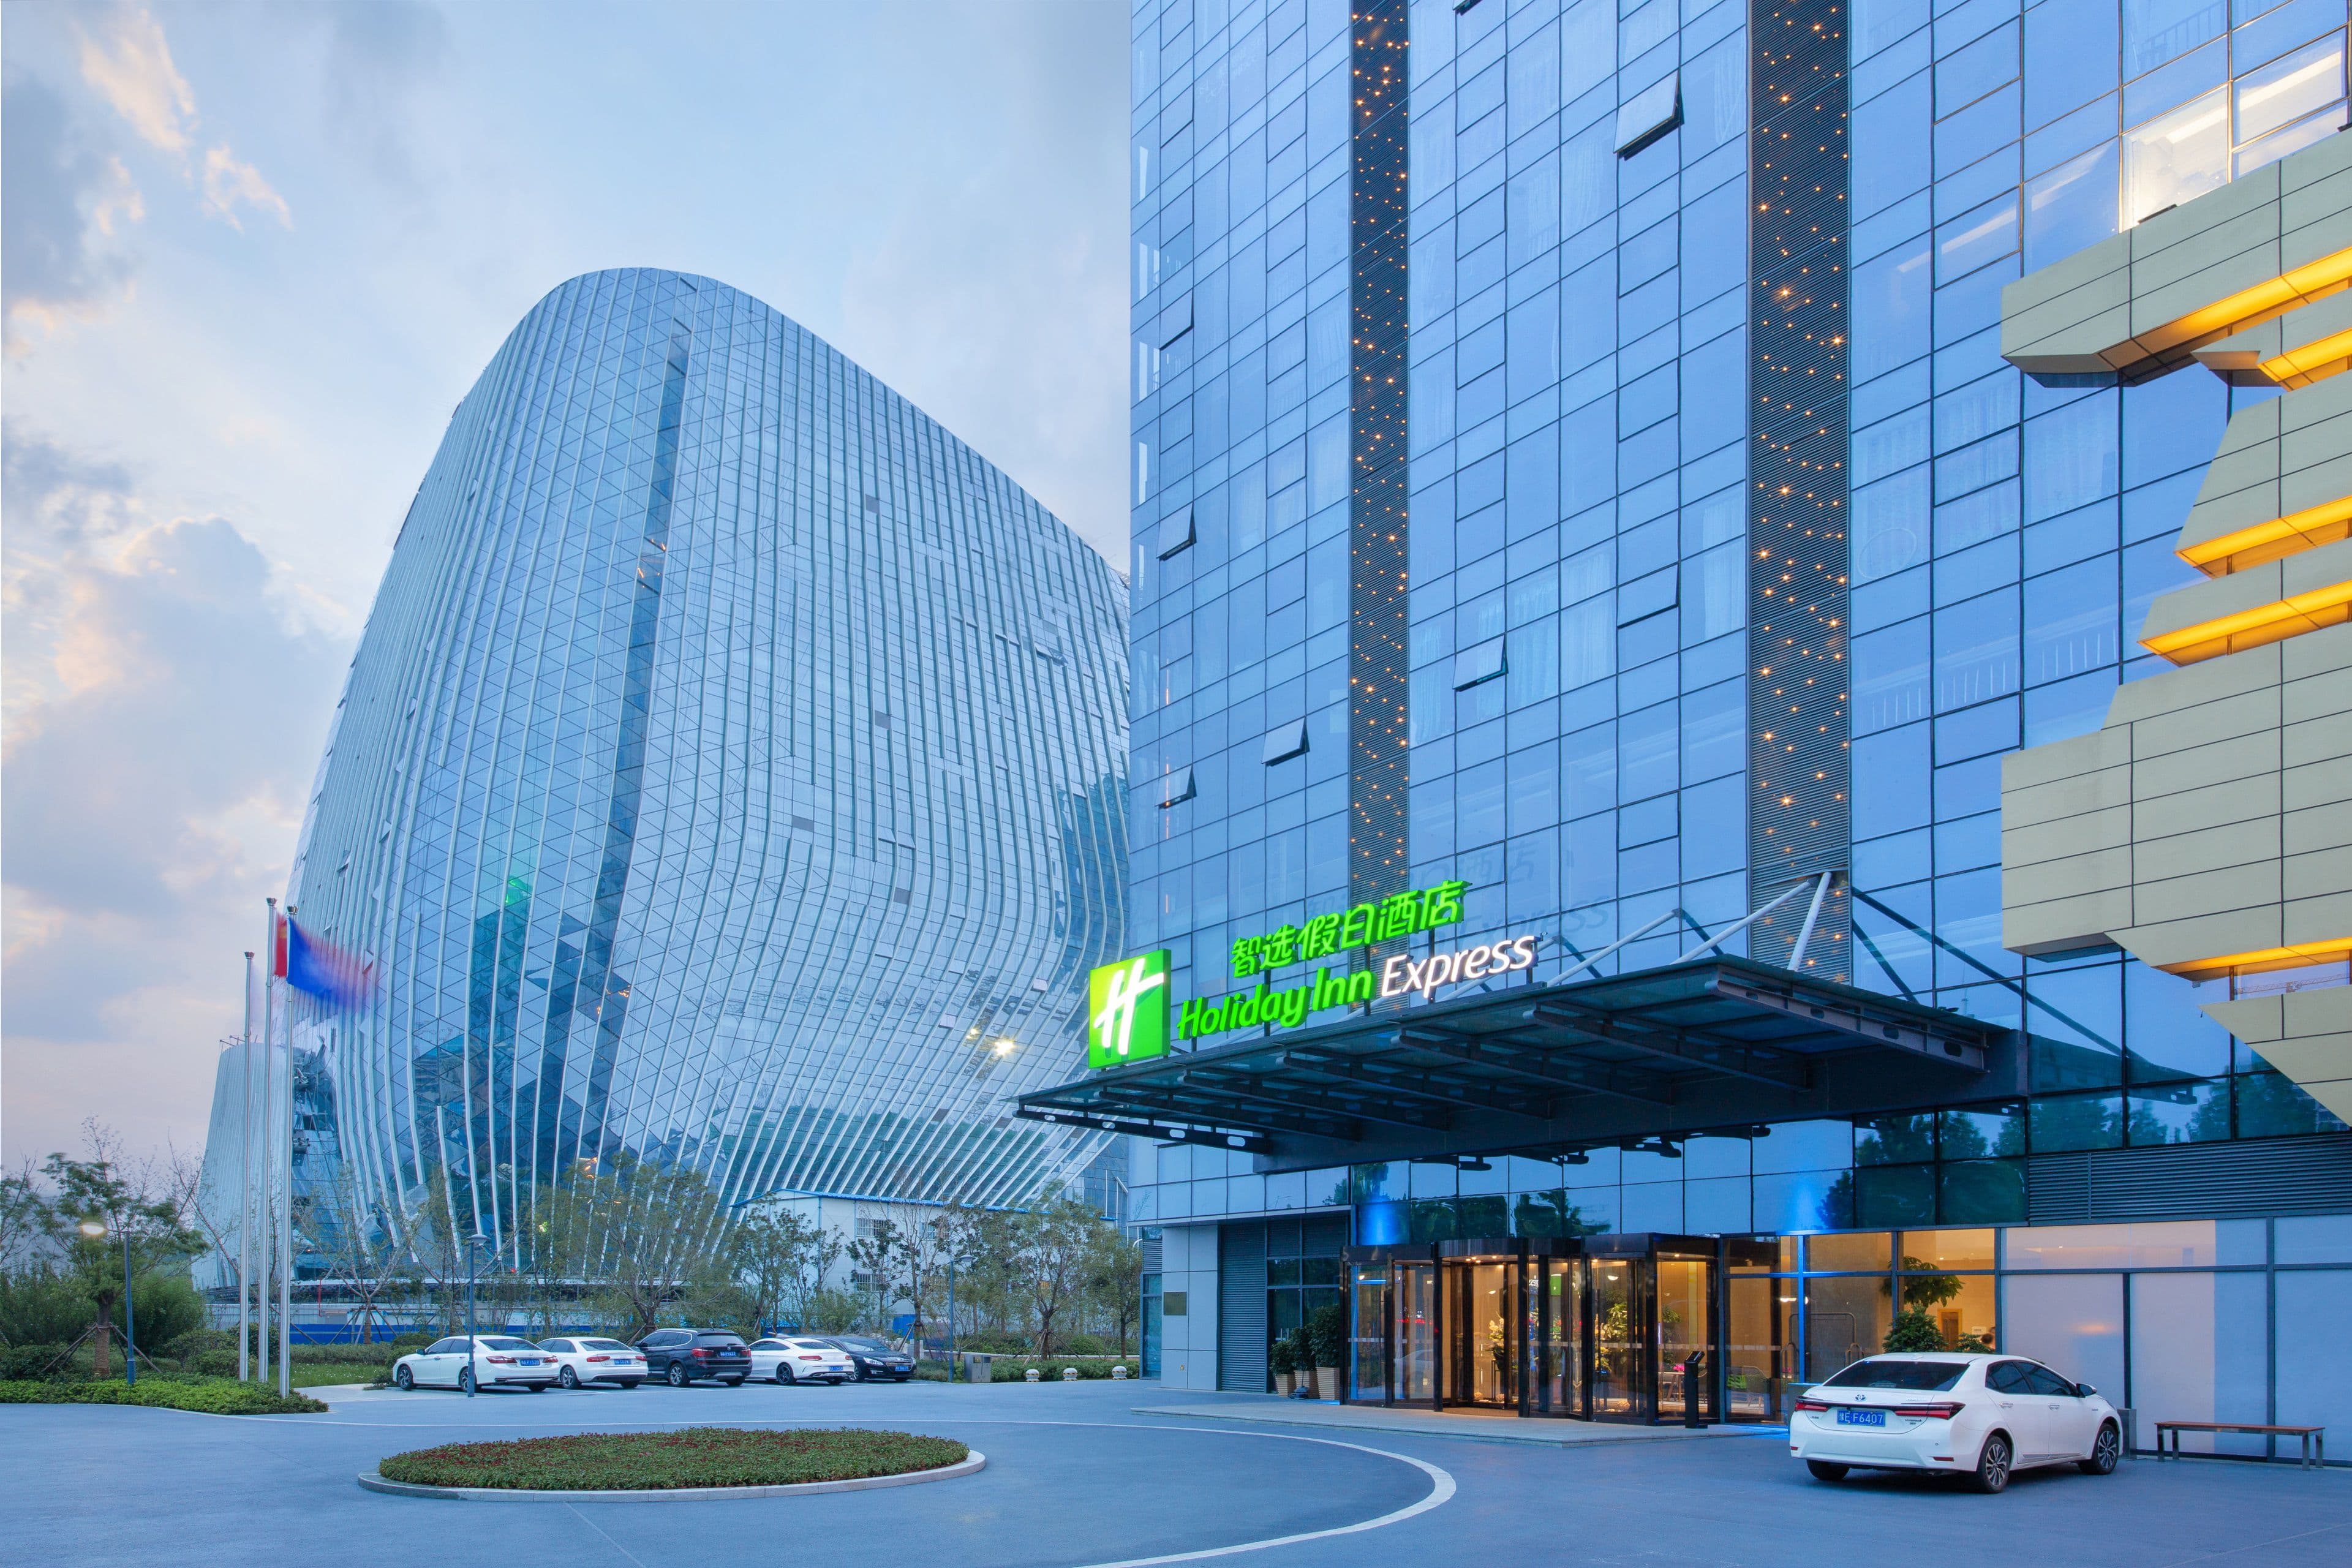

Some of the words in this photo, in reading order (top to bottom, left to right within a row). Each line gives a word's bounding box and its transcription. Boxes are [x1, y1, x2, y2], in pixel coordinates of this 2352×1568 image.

[1230, 880, 1470, 978] 智选假日酒店
[1177, 984, 1313, 1039] Holiday
[1312, 967, 1376, 1011] Inn
[1381, 935, 1537, 998] Express
